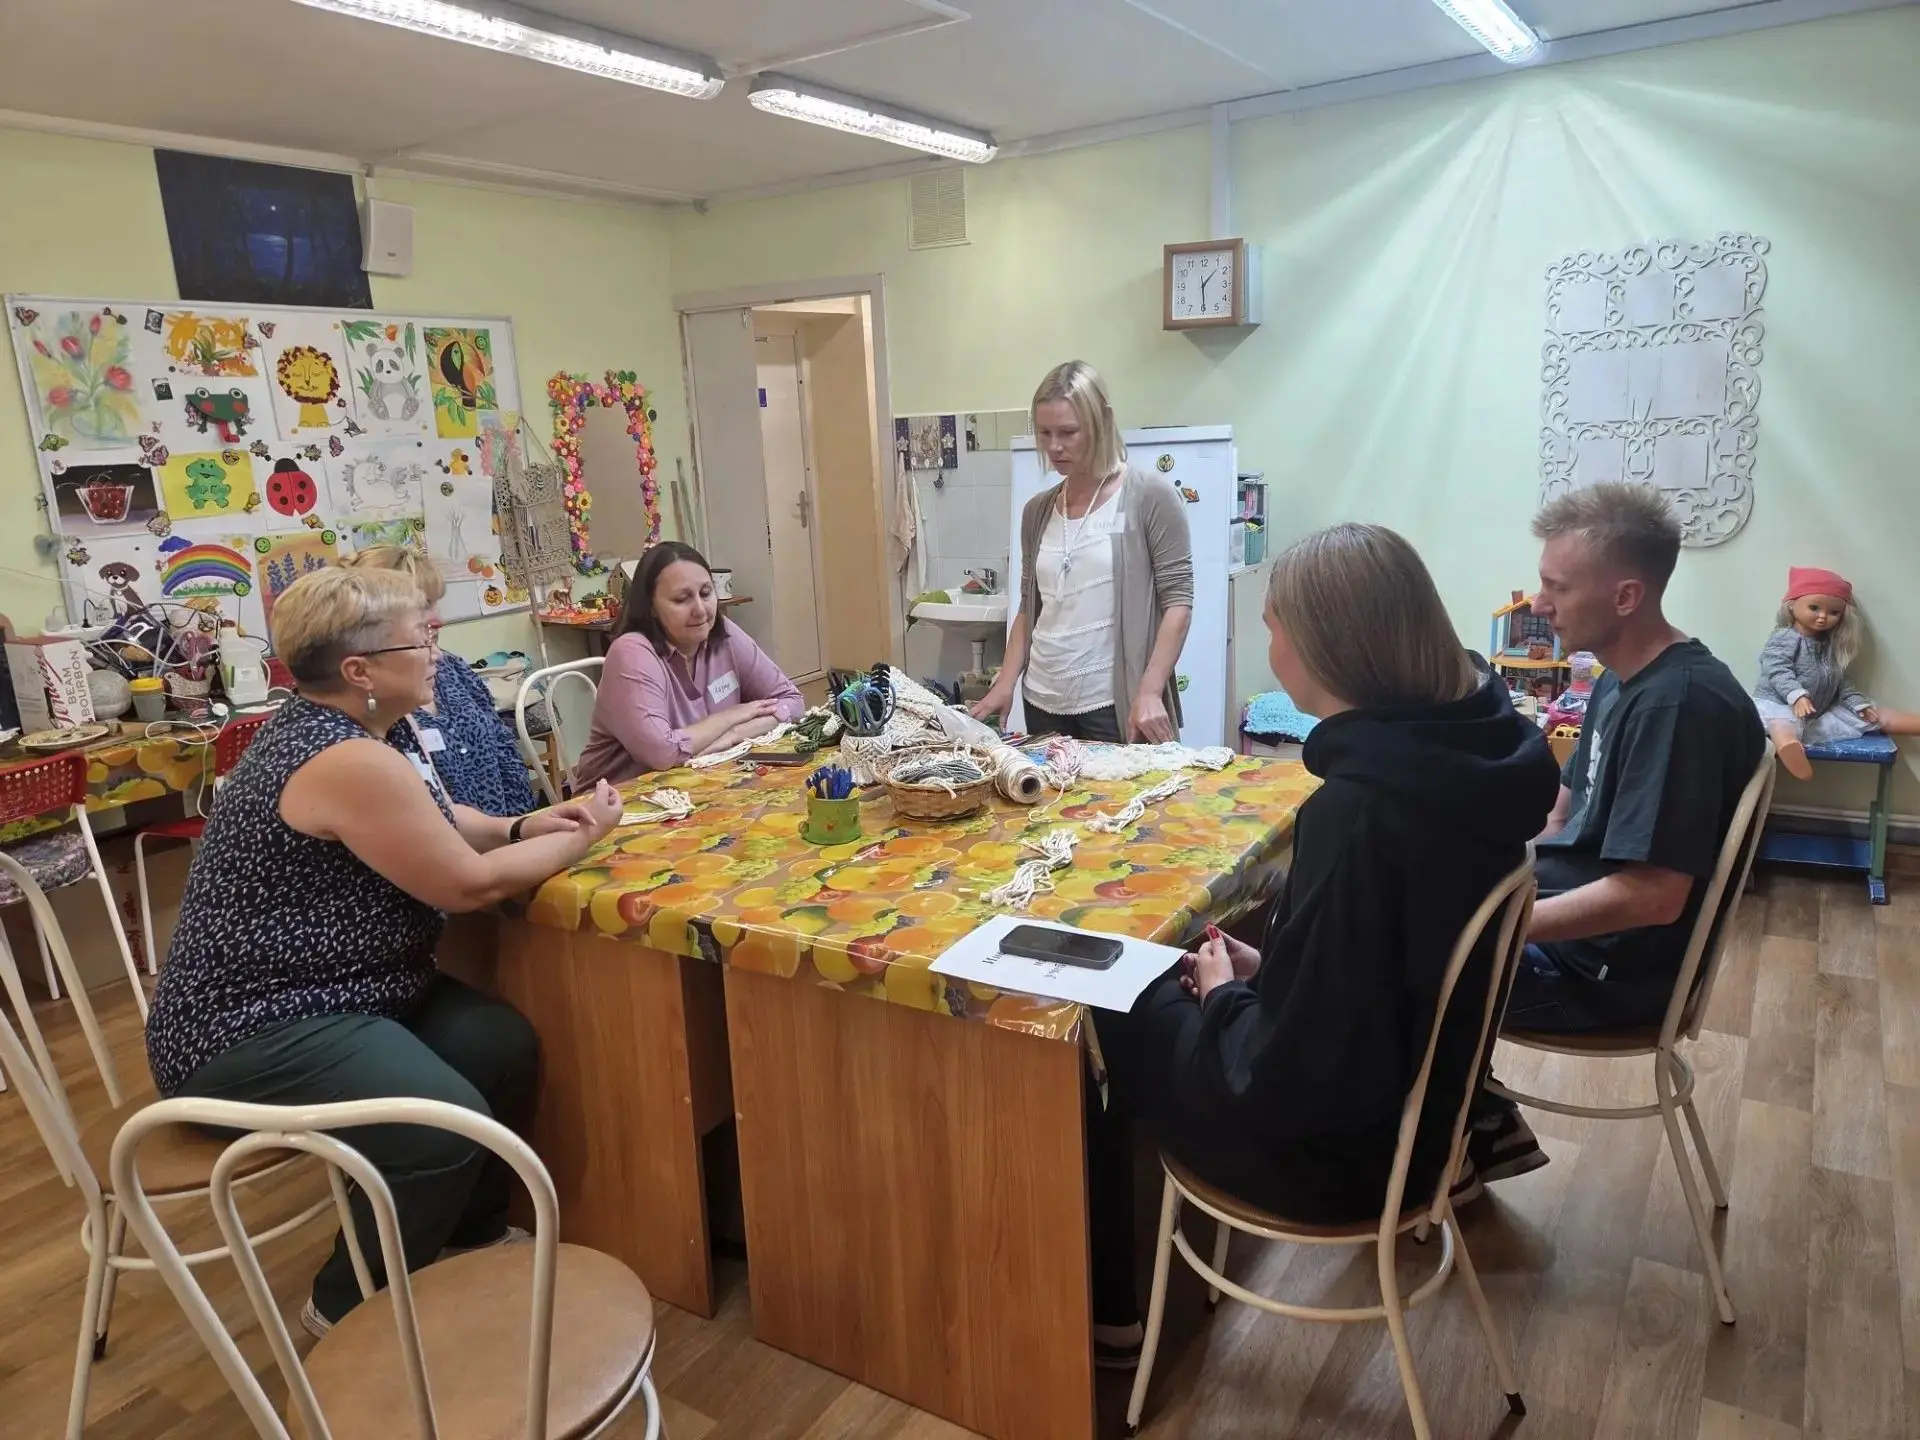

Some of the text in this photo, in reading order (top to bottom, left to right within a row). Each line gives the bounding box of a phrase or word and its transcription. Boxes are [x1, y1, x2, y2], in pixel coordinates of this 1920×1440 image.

[1187, 260, 1194, 268] 11
[1200, 258, 1209, 268] 12
[1222, 266, 1228, 275] 2
[1180, 282, 1186, 291] 9
[1221, 280, 1228, 289] 3
[1180, 296, 1186, 305] 8
[1222, 293, 1227, 302] 4
[1187, 304, 1193, 313] 7
[1200, 303, 1206, 312] 6
[1213, 302, 1220, 311] 5
[62, 667, 77, 705] BEAM
[70, 650, 91, 717] BOURBON
